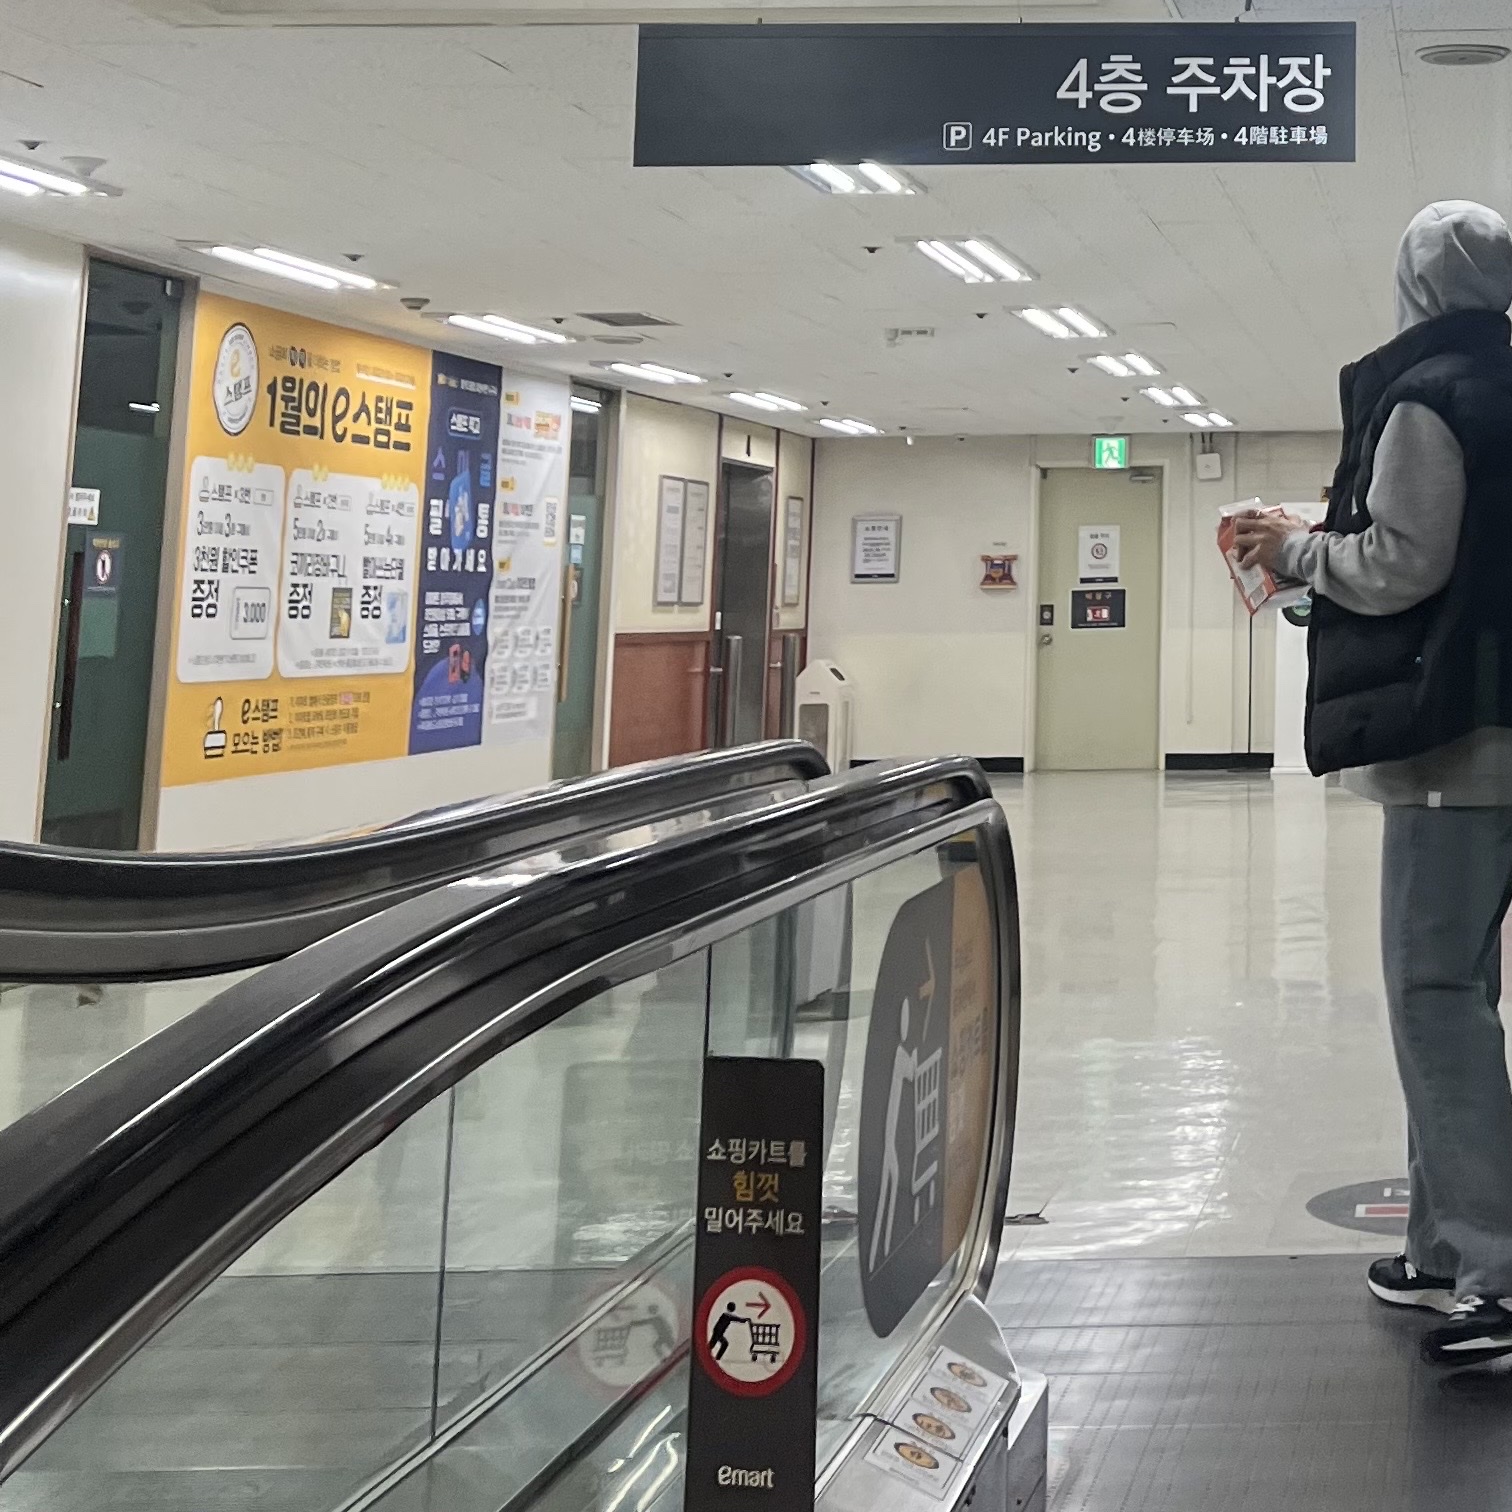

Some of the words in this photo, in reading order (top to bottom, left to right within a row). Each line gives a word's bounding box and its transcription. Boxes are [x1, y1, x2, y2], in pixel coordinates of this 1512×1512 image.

[1056, 54, 1148, 114] 4층
[1166, 53, 1332, 113] 주차장
[982, 127, 1010, 147] 4F
[1016, 126, 1102, 152] Parking
[1121, 126, 1215, 147] 4楼停车场
[1233, 125, 1329, 146] 4階駐車場
[267, 376, 328, 440] 1월의
[191, 579, 220, 619] 증정
[288, 583, 313, 619] 증정
[360, 584, 384, 619] 증정
[706, 1138, 808, 1168] 쇼핑카트를
[733, 1170, 780, 1204] 힘껏
[704, 1206, 806, 1237] 밀어주세요
[717, 1465, 776, 1488] emart
